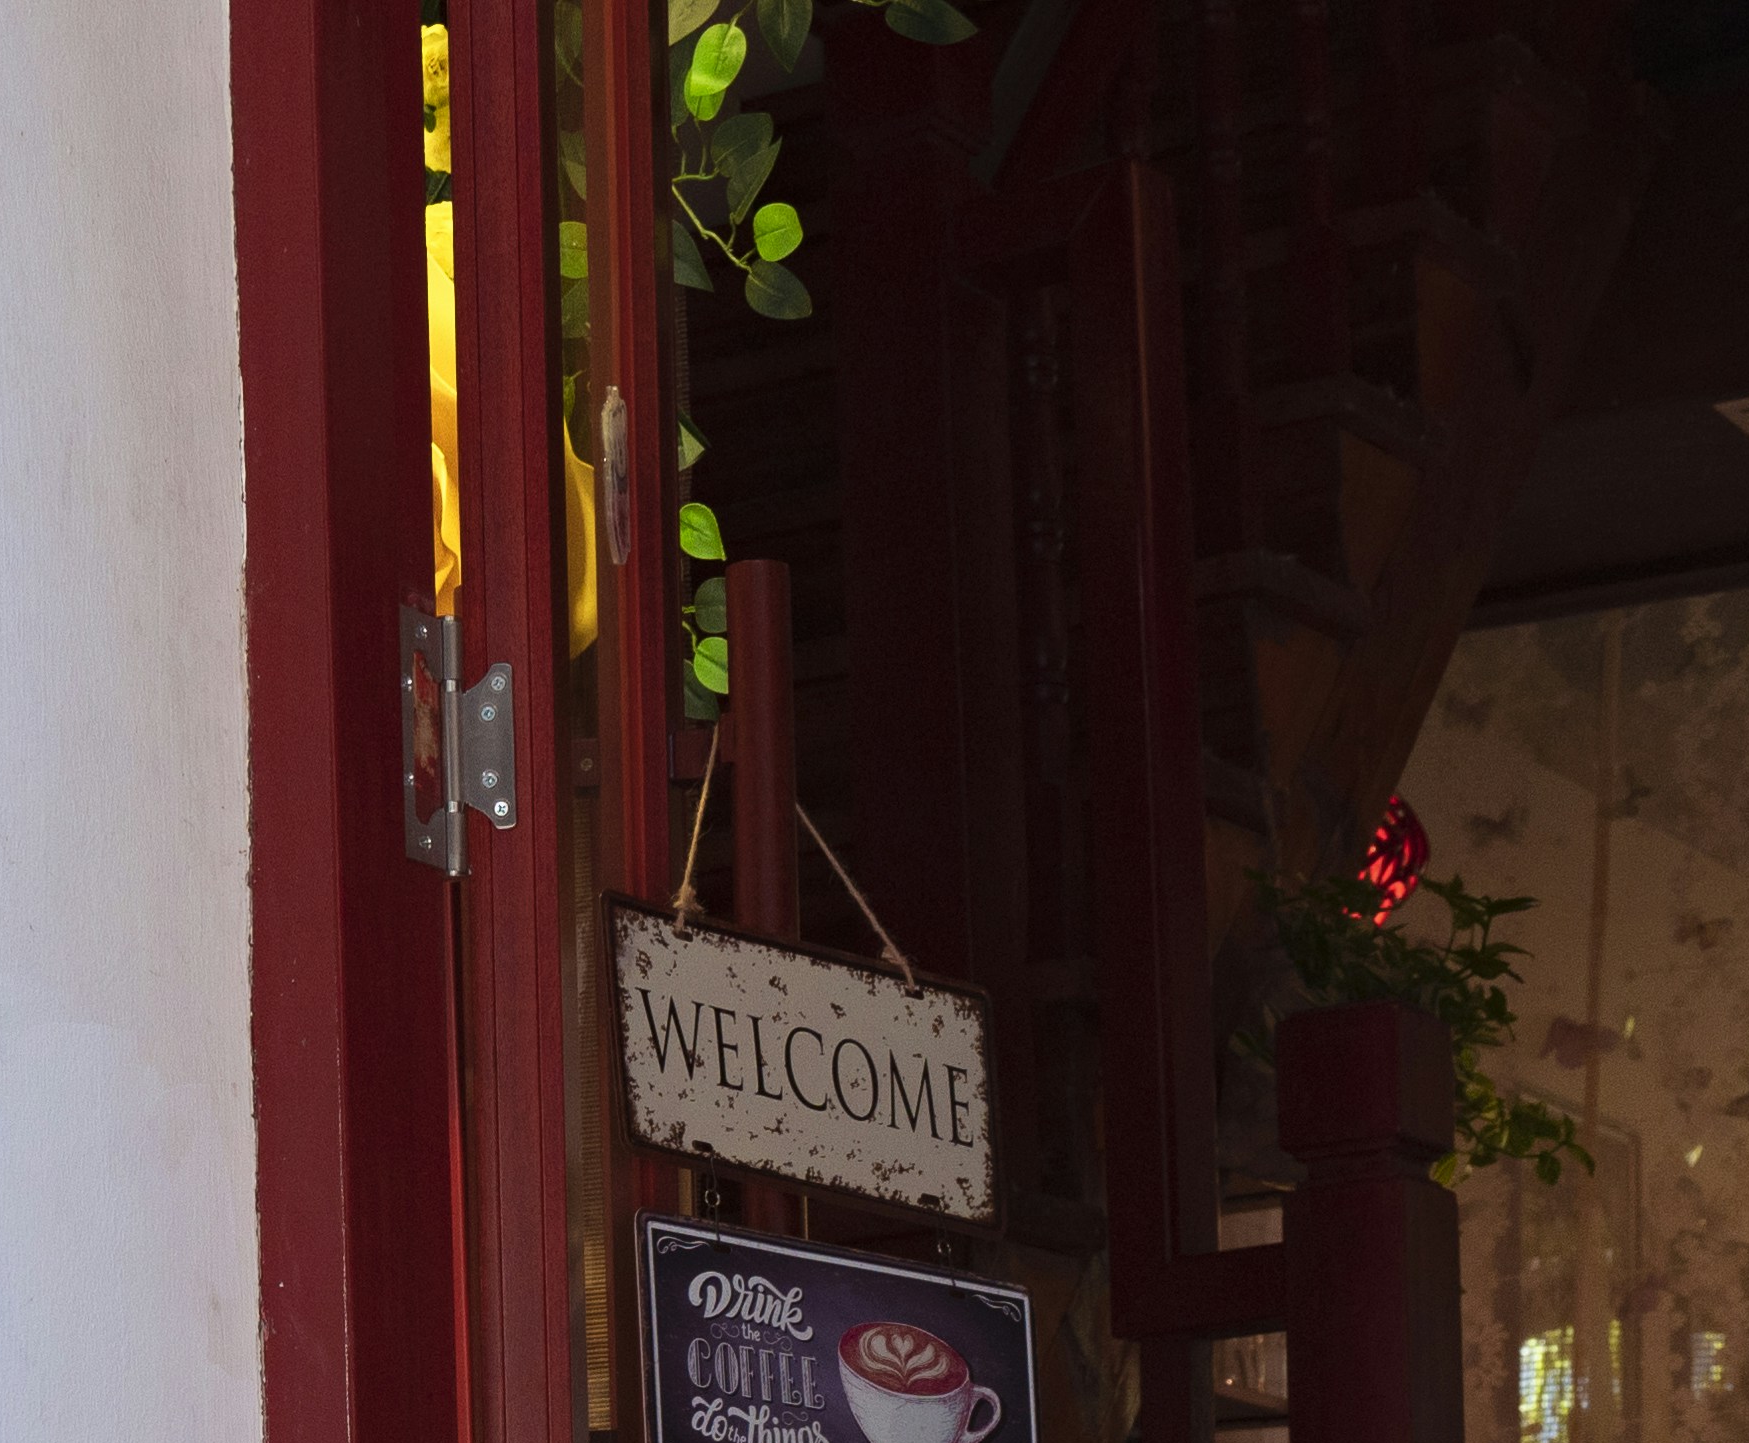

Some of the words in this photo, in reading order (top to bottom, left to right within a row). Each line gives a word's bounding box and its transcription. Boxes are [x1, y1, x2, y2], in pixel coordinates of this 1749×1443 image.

[635, 987, 974, 1148] WELCOME
[688, 1271, 813, 1341] Drink
[741, 1322, 761, 1342] the
[687, 1337, 825, 1409] COFFEE
[691, 1396, 728, 1441] do
